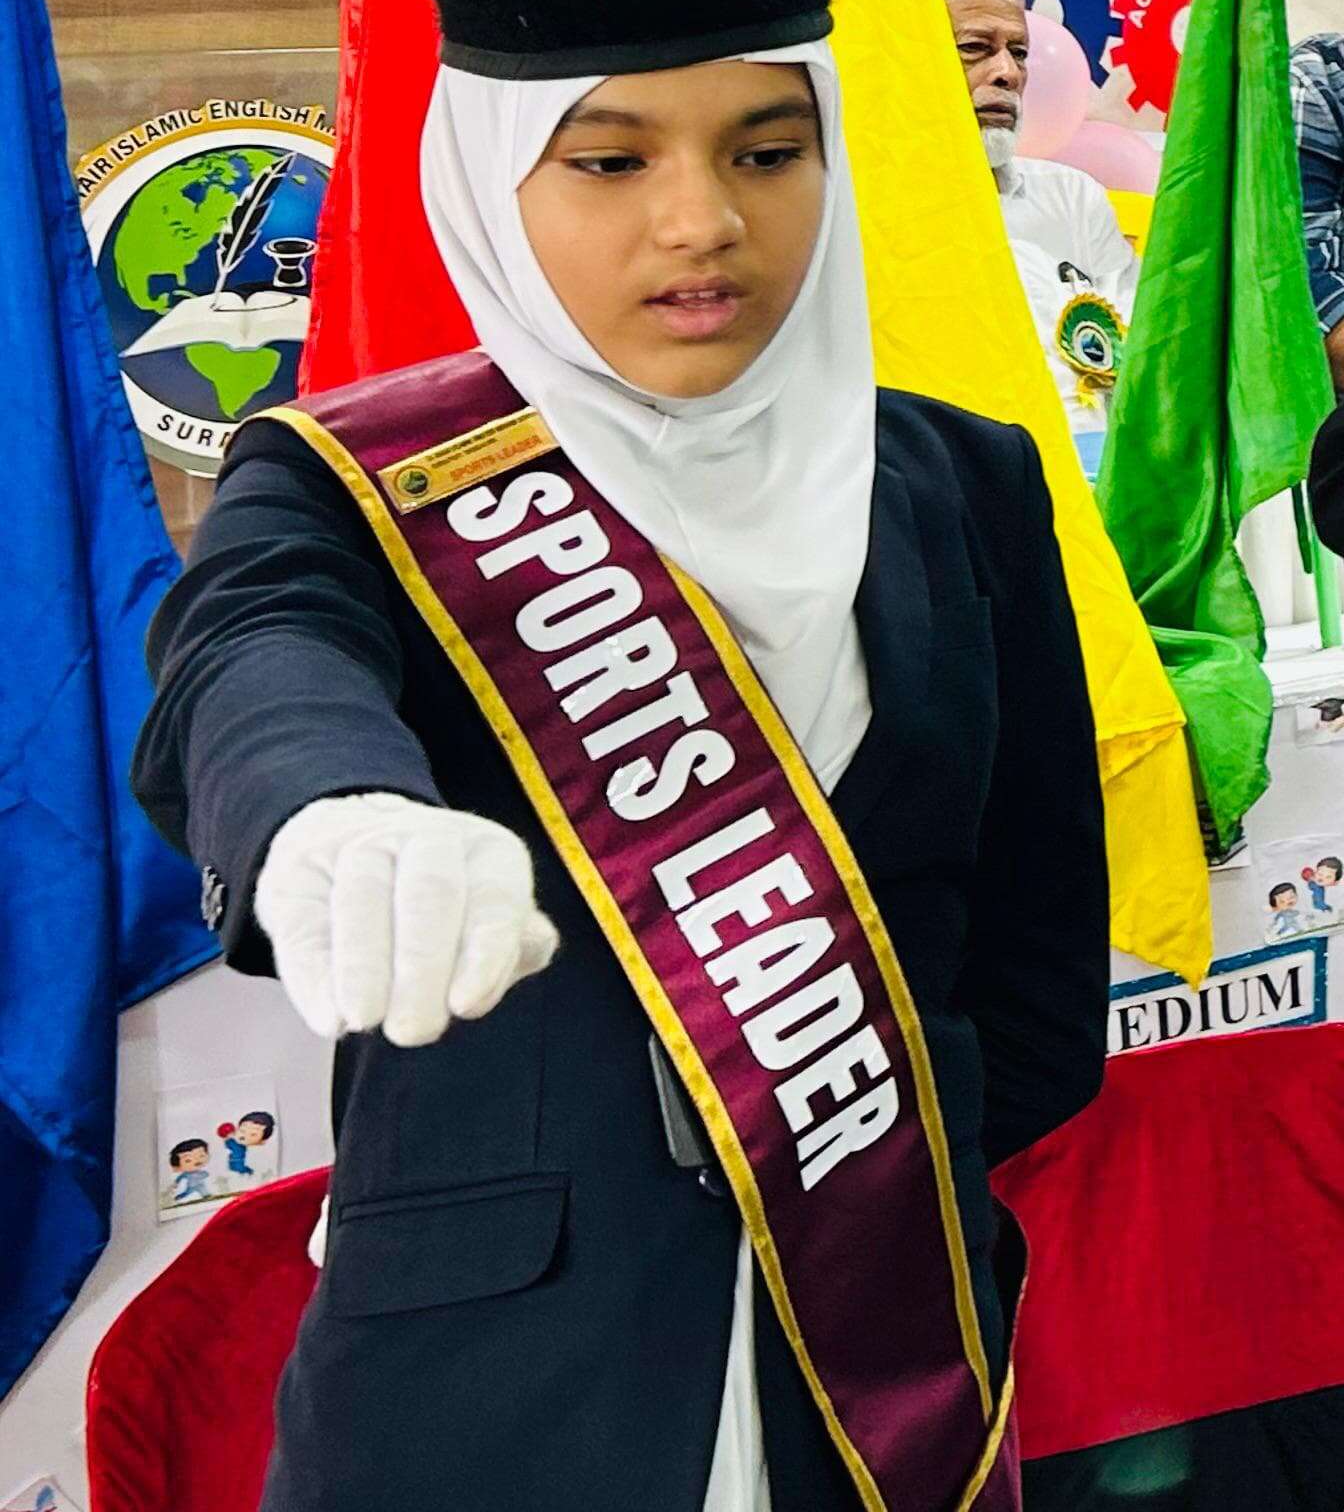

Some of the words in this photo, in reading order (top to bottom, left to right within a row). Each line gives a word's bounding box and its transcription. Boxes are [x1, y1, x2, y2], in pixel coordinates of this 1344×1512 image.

[78, 156, 114, 198] AIR
[111, 107, 203, 162] ISLAMIC
[209, 100, 309, 125] ENGLISH
[446, 470, 736, 822] SPORTS
[651, 806, 900, 1192] LEADER
[1117, 965, 1305, 1051] EDIUM
